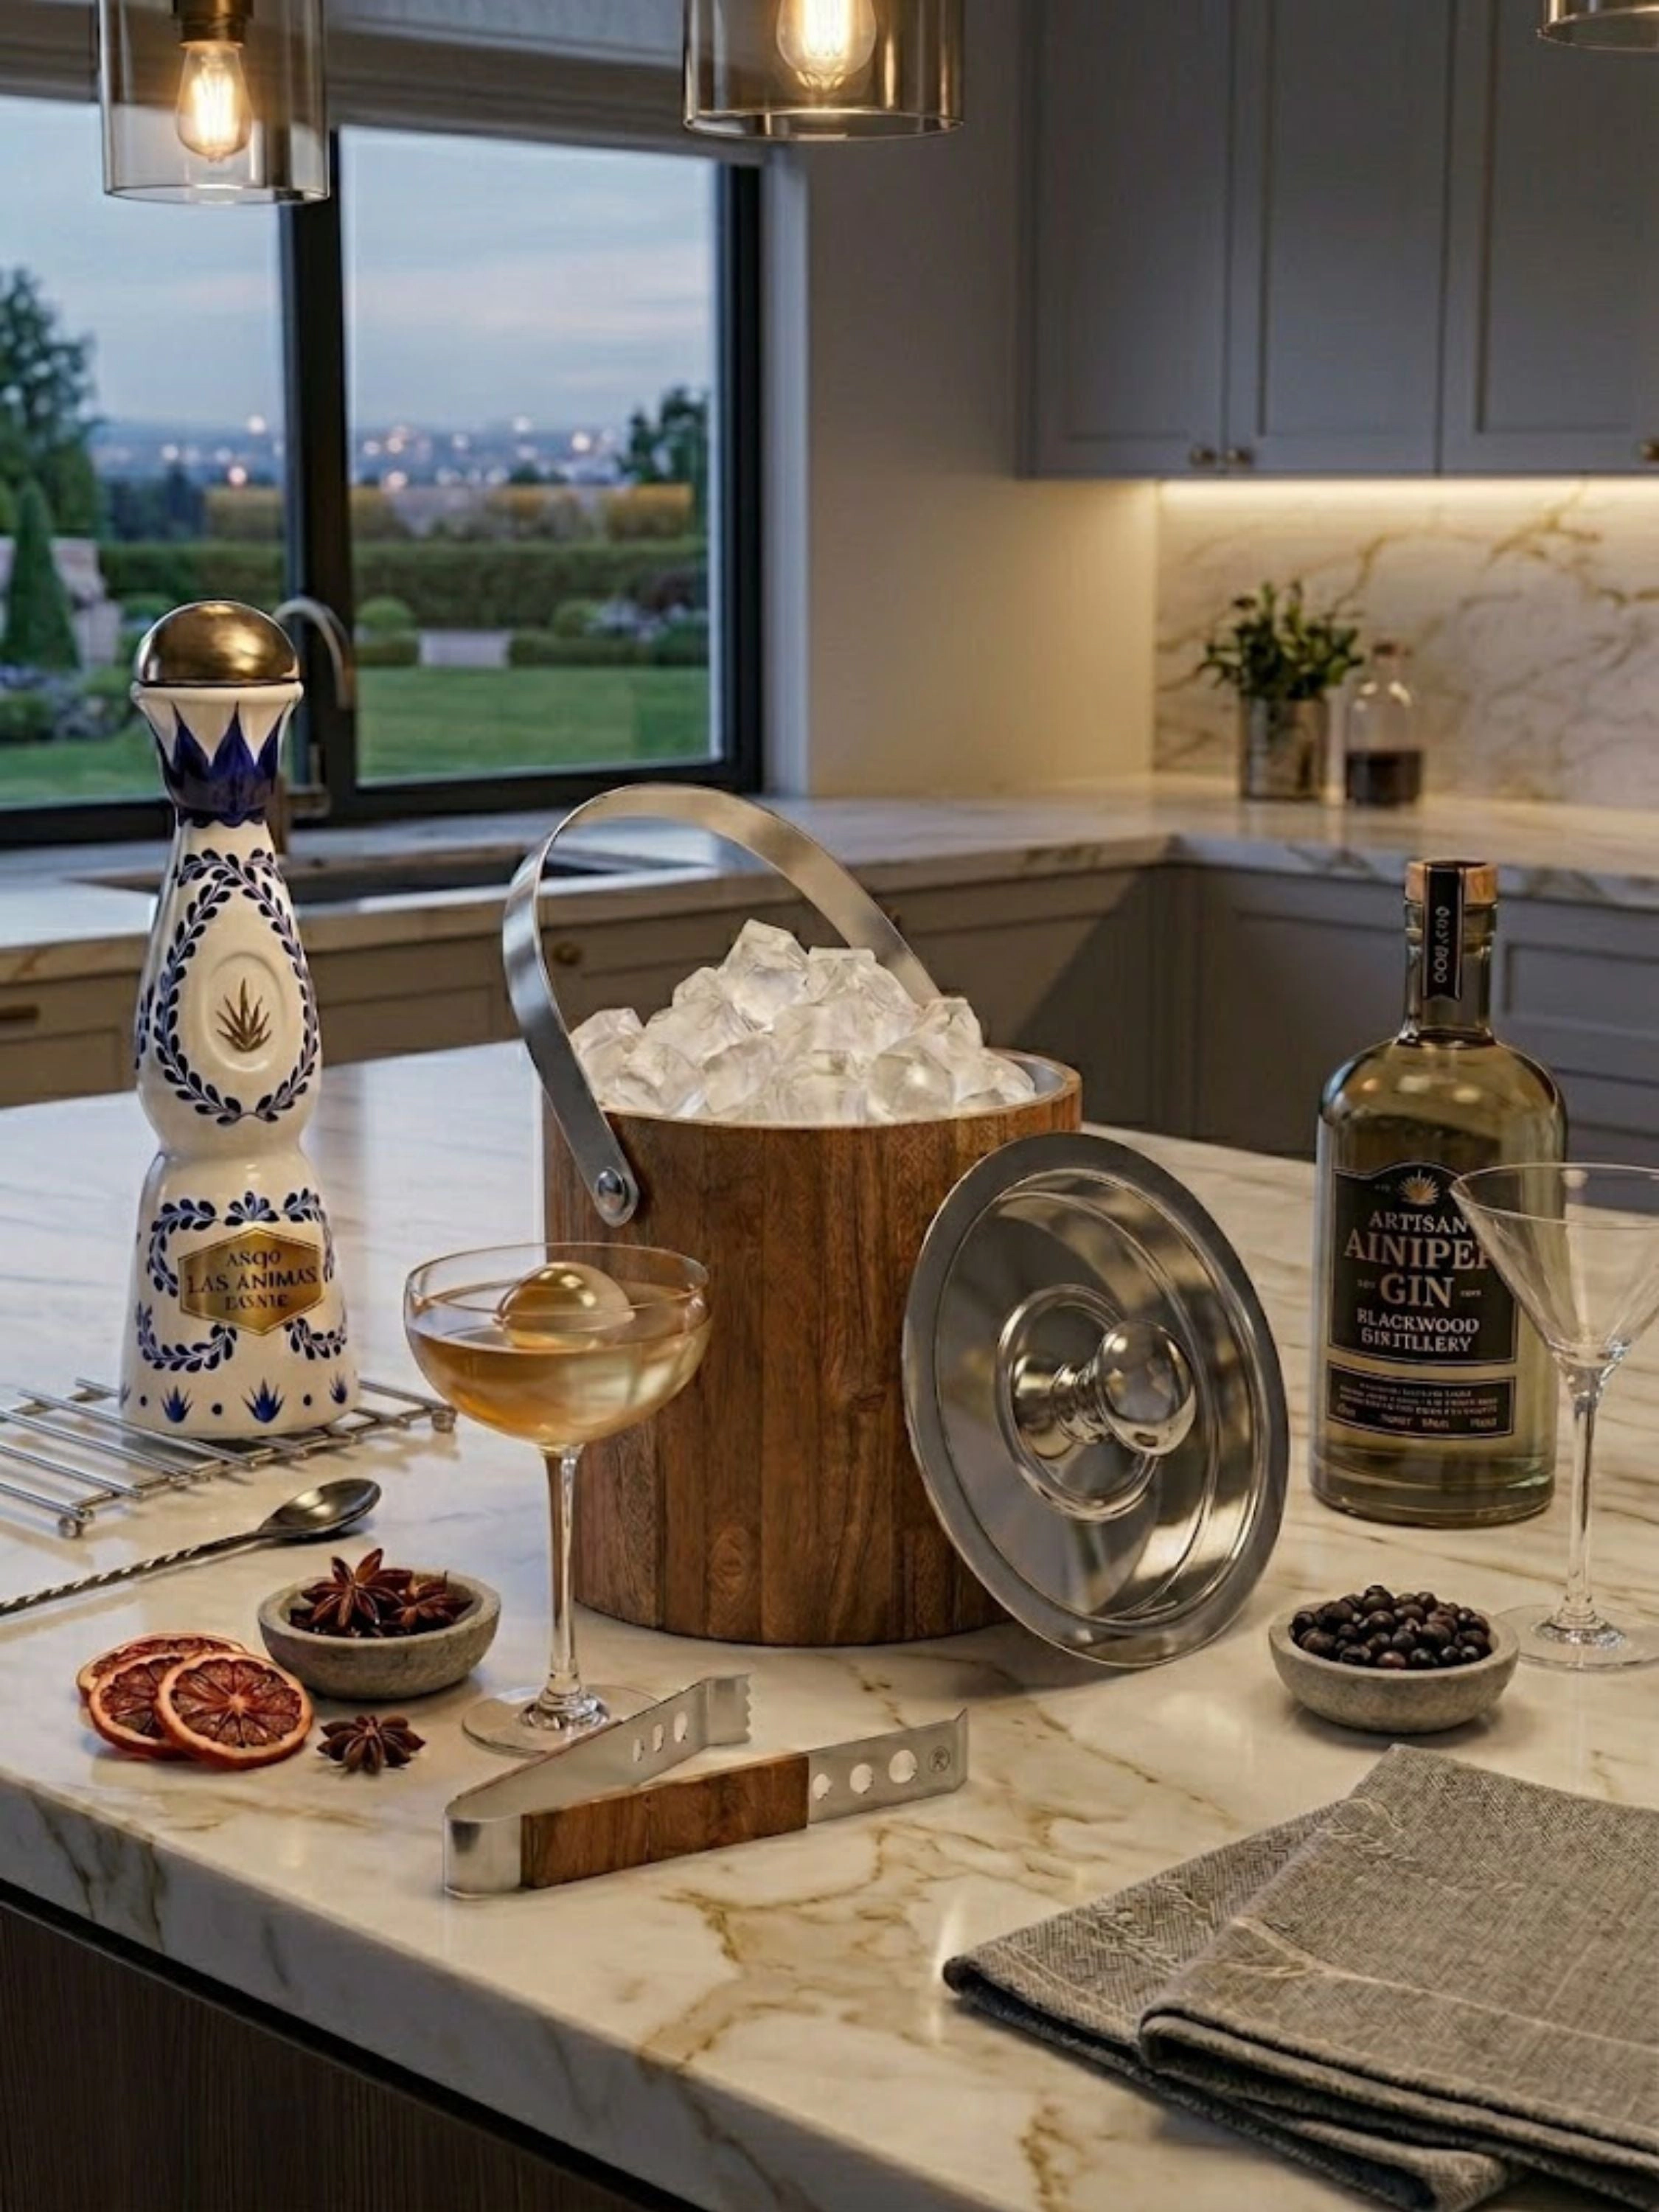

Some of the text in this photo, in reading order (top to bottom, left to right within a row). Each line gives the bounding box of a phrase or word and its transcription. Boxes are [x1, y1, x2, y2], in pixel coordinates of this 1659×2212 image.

[1368, 1210, 1467, 1234] ARTISAN
[187, 1267, 318, 1293] LAS ANIMAS
[1380, 1272, 1455, 1309] GIN
